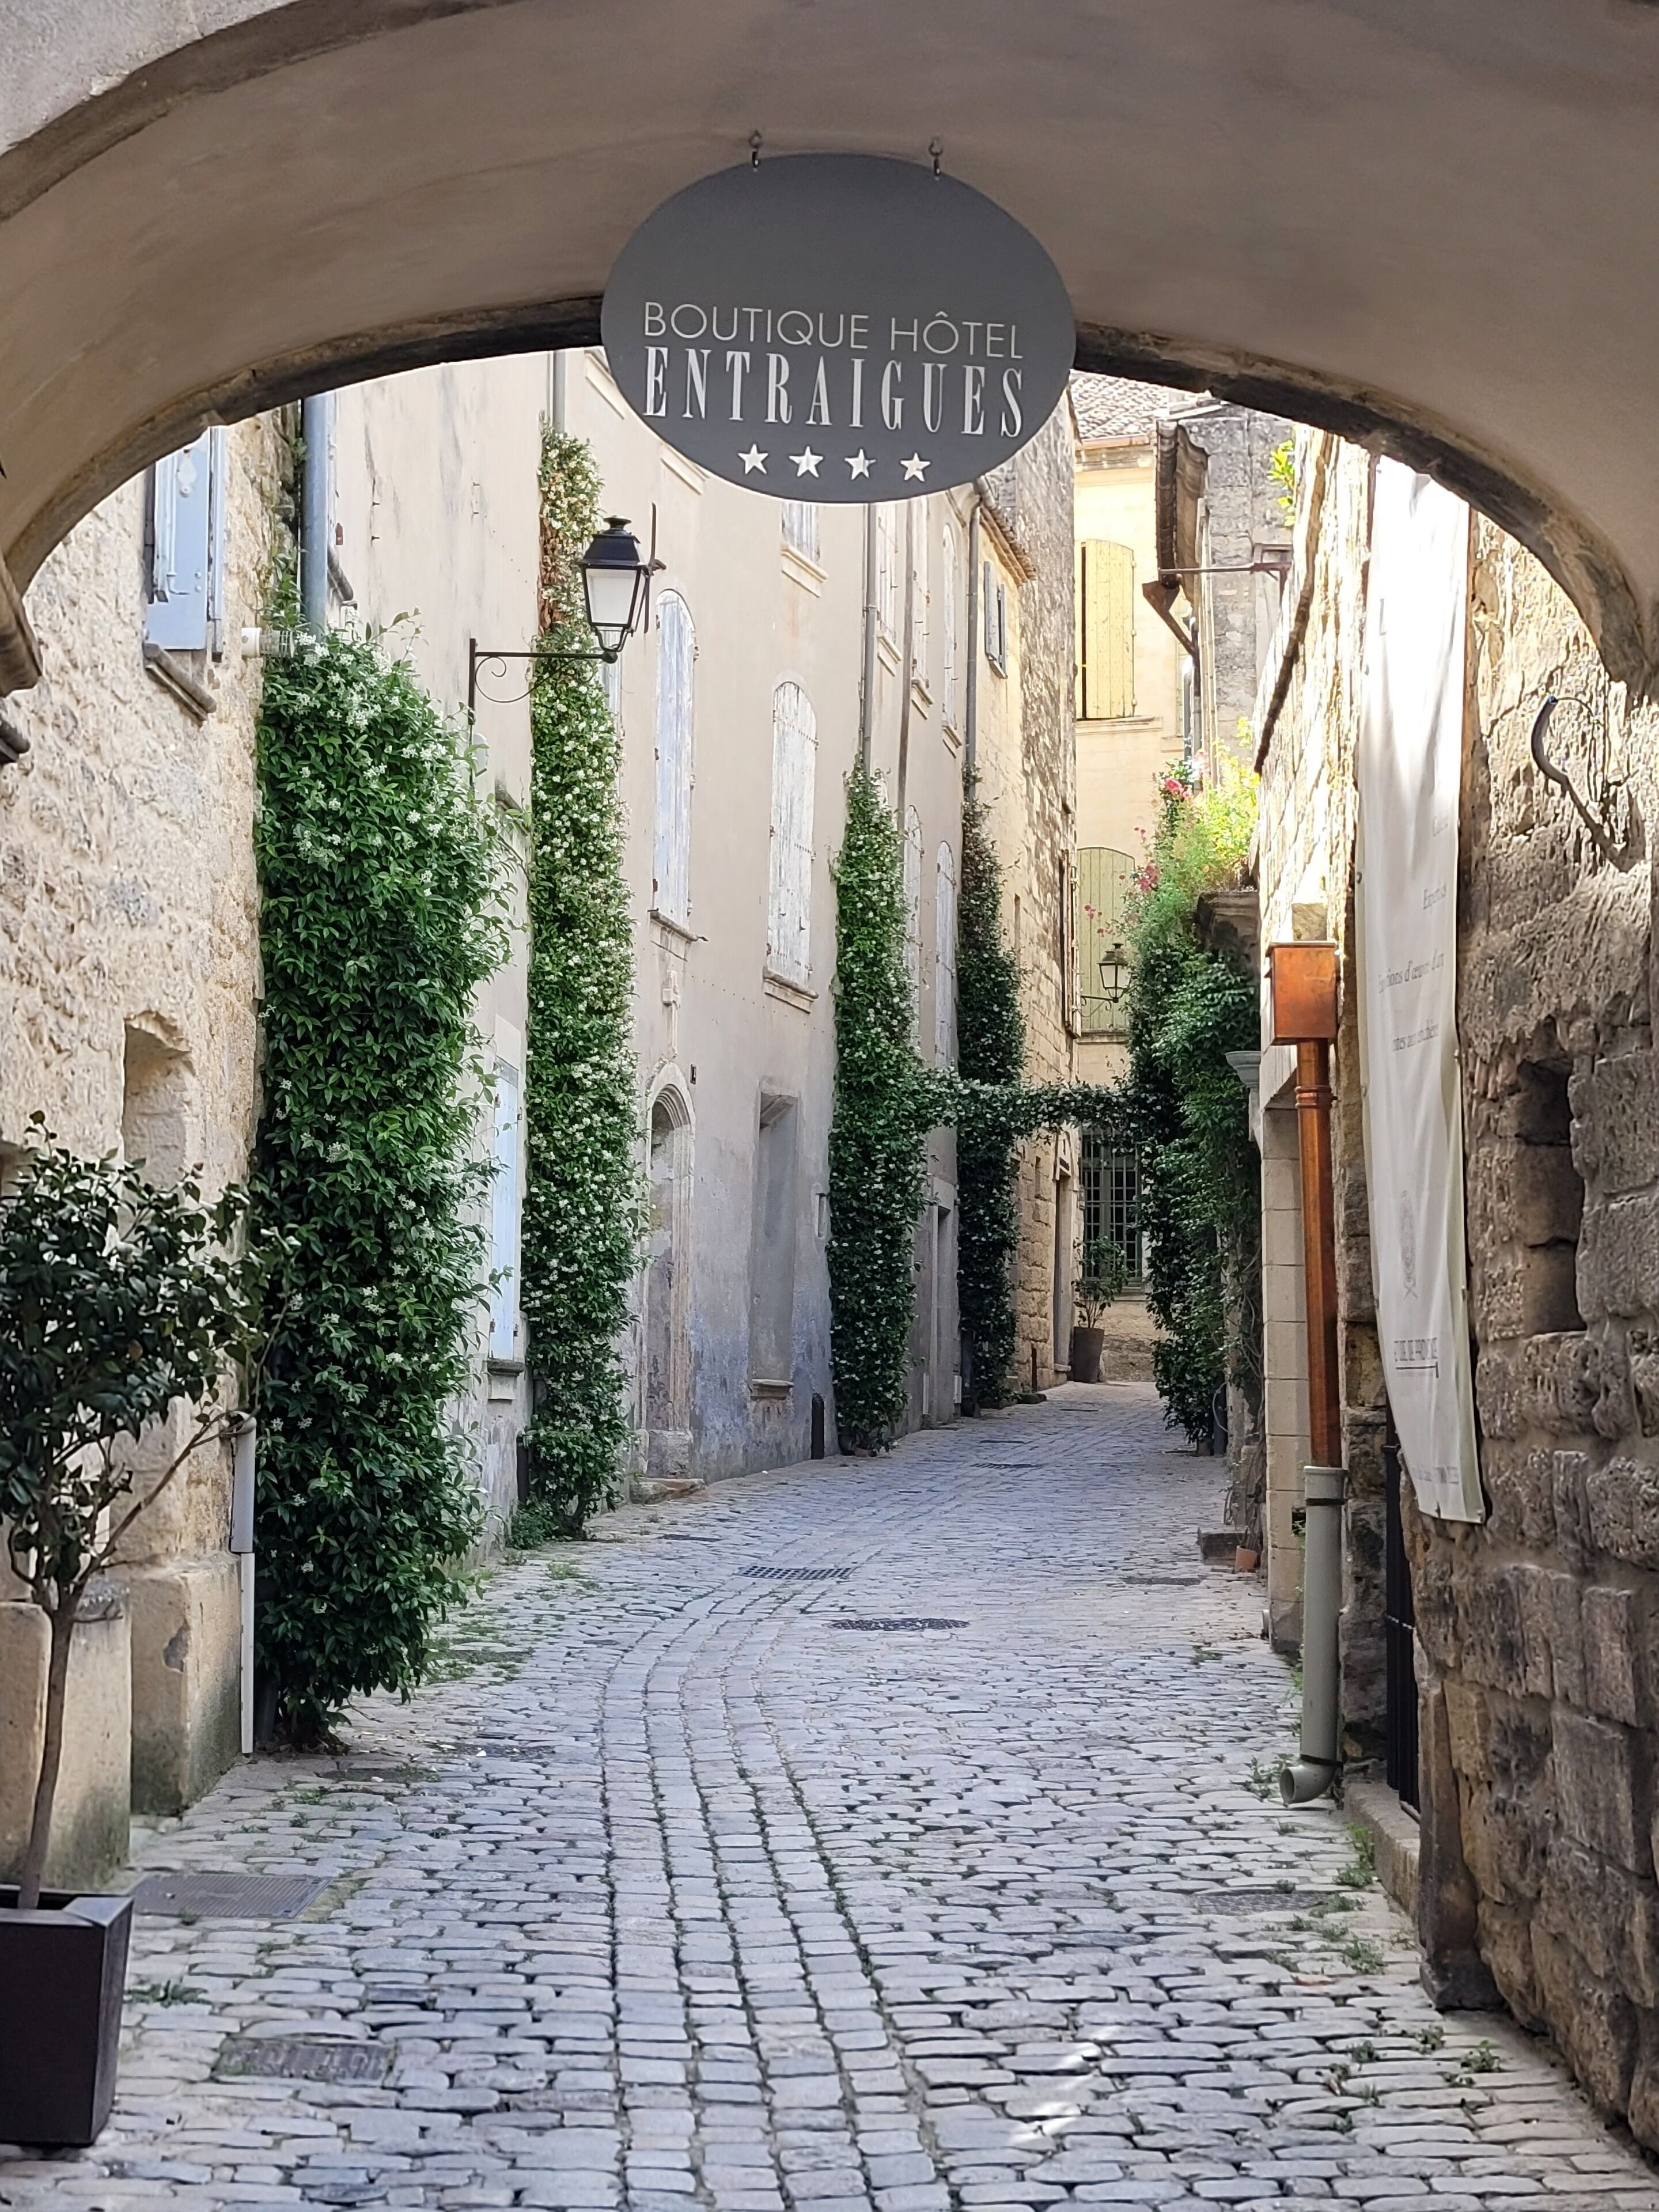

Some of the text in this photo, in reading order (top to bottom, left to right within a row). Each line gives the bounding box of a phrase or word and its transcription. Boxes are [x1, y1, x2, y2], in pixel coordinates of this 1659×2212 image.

[645, 301, 1023, 359] BOUTIQUE HÔTEL
[643, 346, 1022, 438] ENTRAIGUES
